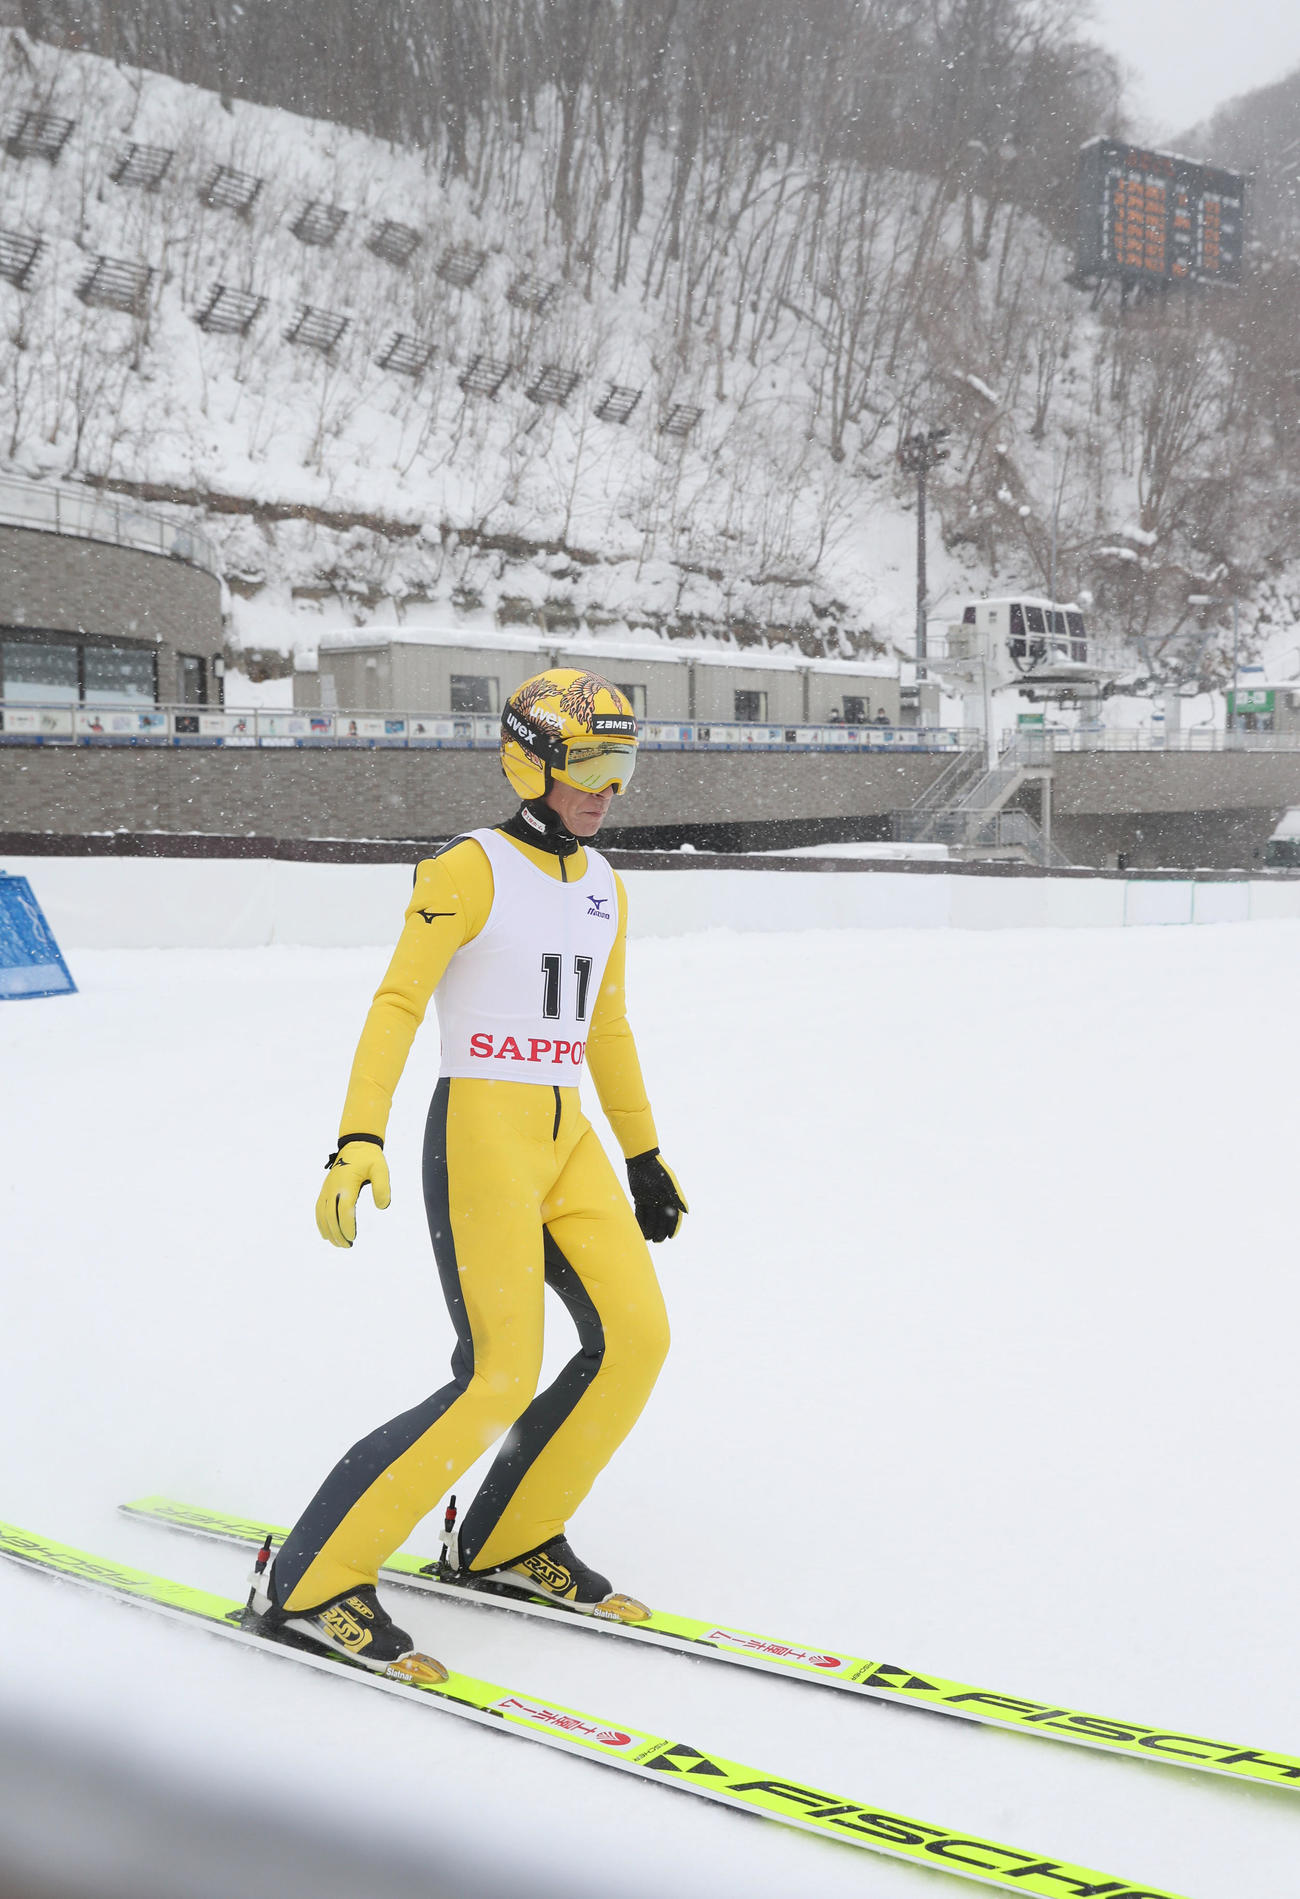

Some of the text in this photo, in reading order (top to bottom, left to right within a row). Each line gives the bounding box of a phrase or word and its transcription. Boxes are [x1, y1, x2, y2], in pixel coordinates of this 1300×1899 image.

[506, 711, 538, 746] uvex
[529, 704, 567, 731] uvex
[541, 953, 593, 1022] 11
[469, 1032, 586, 1066] SAPPO
[525, 1557, 564, 1584] RASS
[321, 1607, 359, 1638] RASS
[385, 1667, 413, 1681] Slatnar
[498, 1697, 598, 1736] 土屋ホーム
